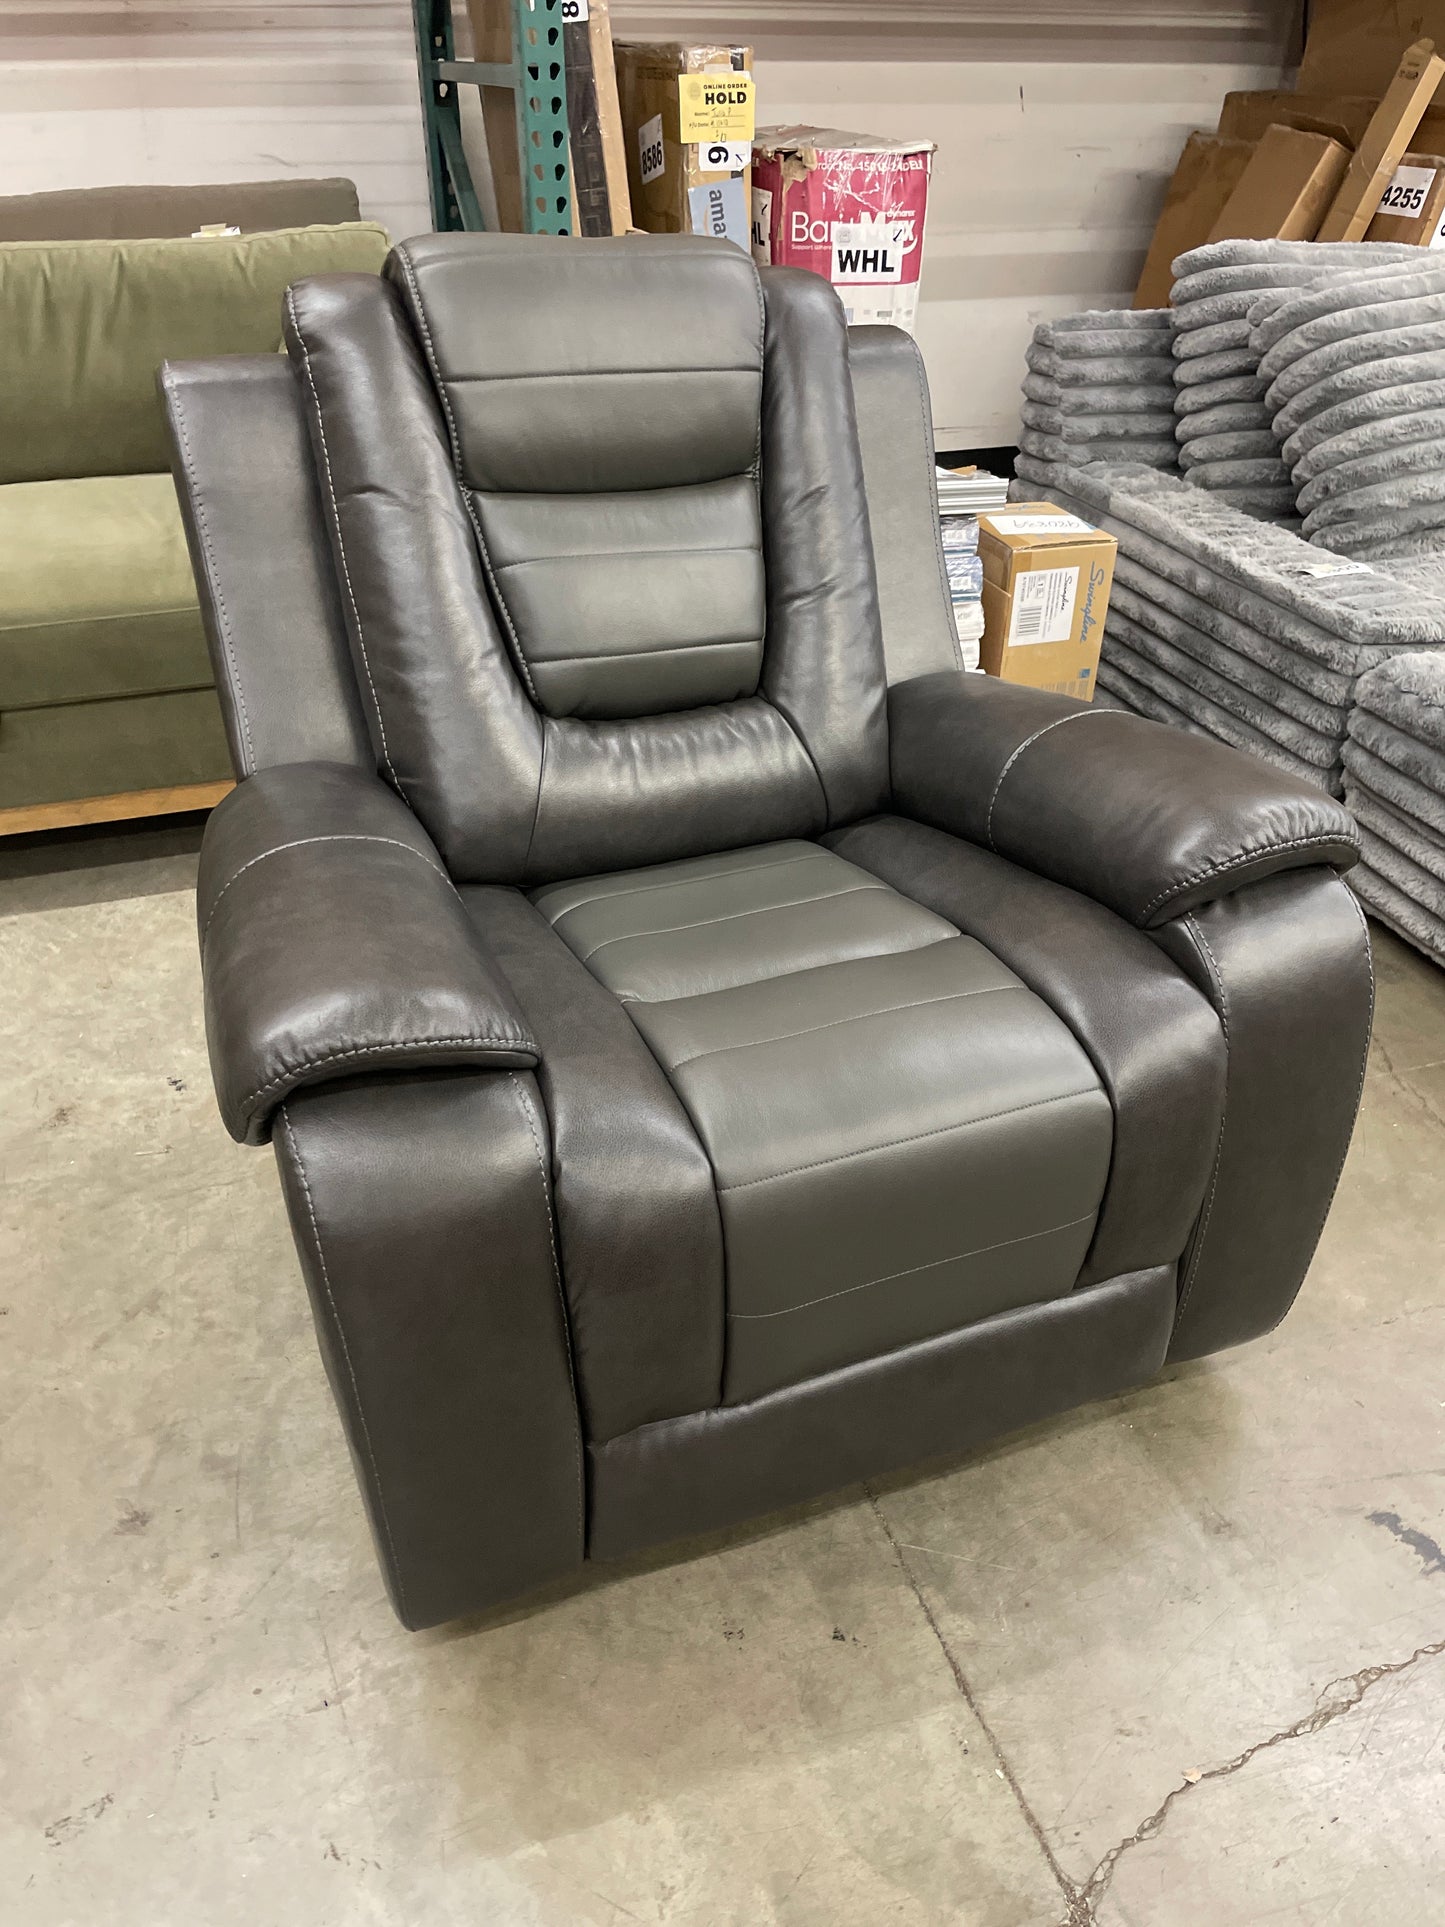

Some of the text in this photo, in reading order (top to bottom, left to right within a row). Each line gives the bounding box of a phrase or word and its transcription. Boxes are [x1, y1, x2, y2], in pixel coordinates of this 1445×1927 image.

[705, 91, 747, 105] HOLD
[642, 140, 663, 175] 8586
[1380, 185, 1425, 210] 4255
[837, 249, 895, 273] WHL
[1059, 571, 1073, 612] Swingline
[1079, 561, 1105, 645] Swingline
